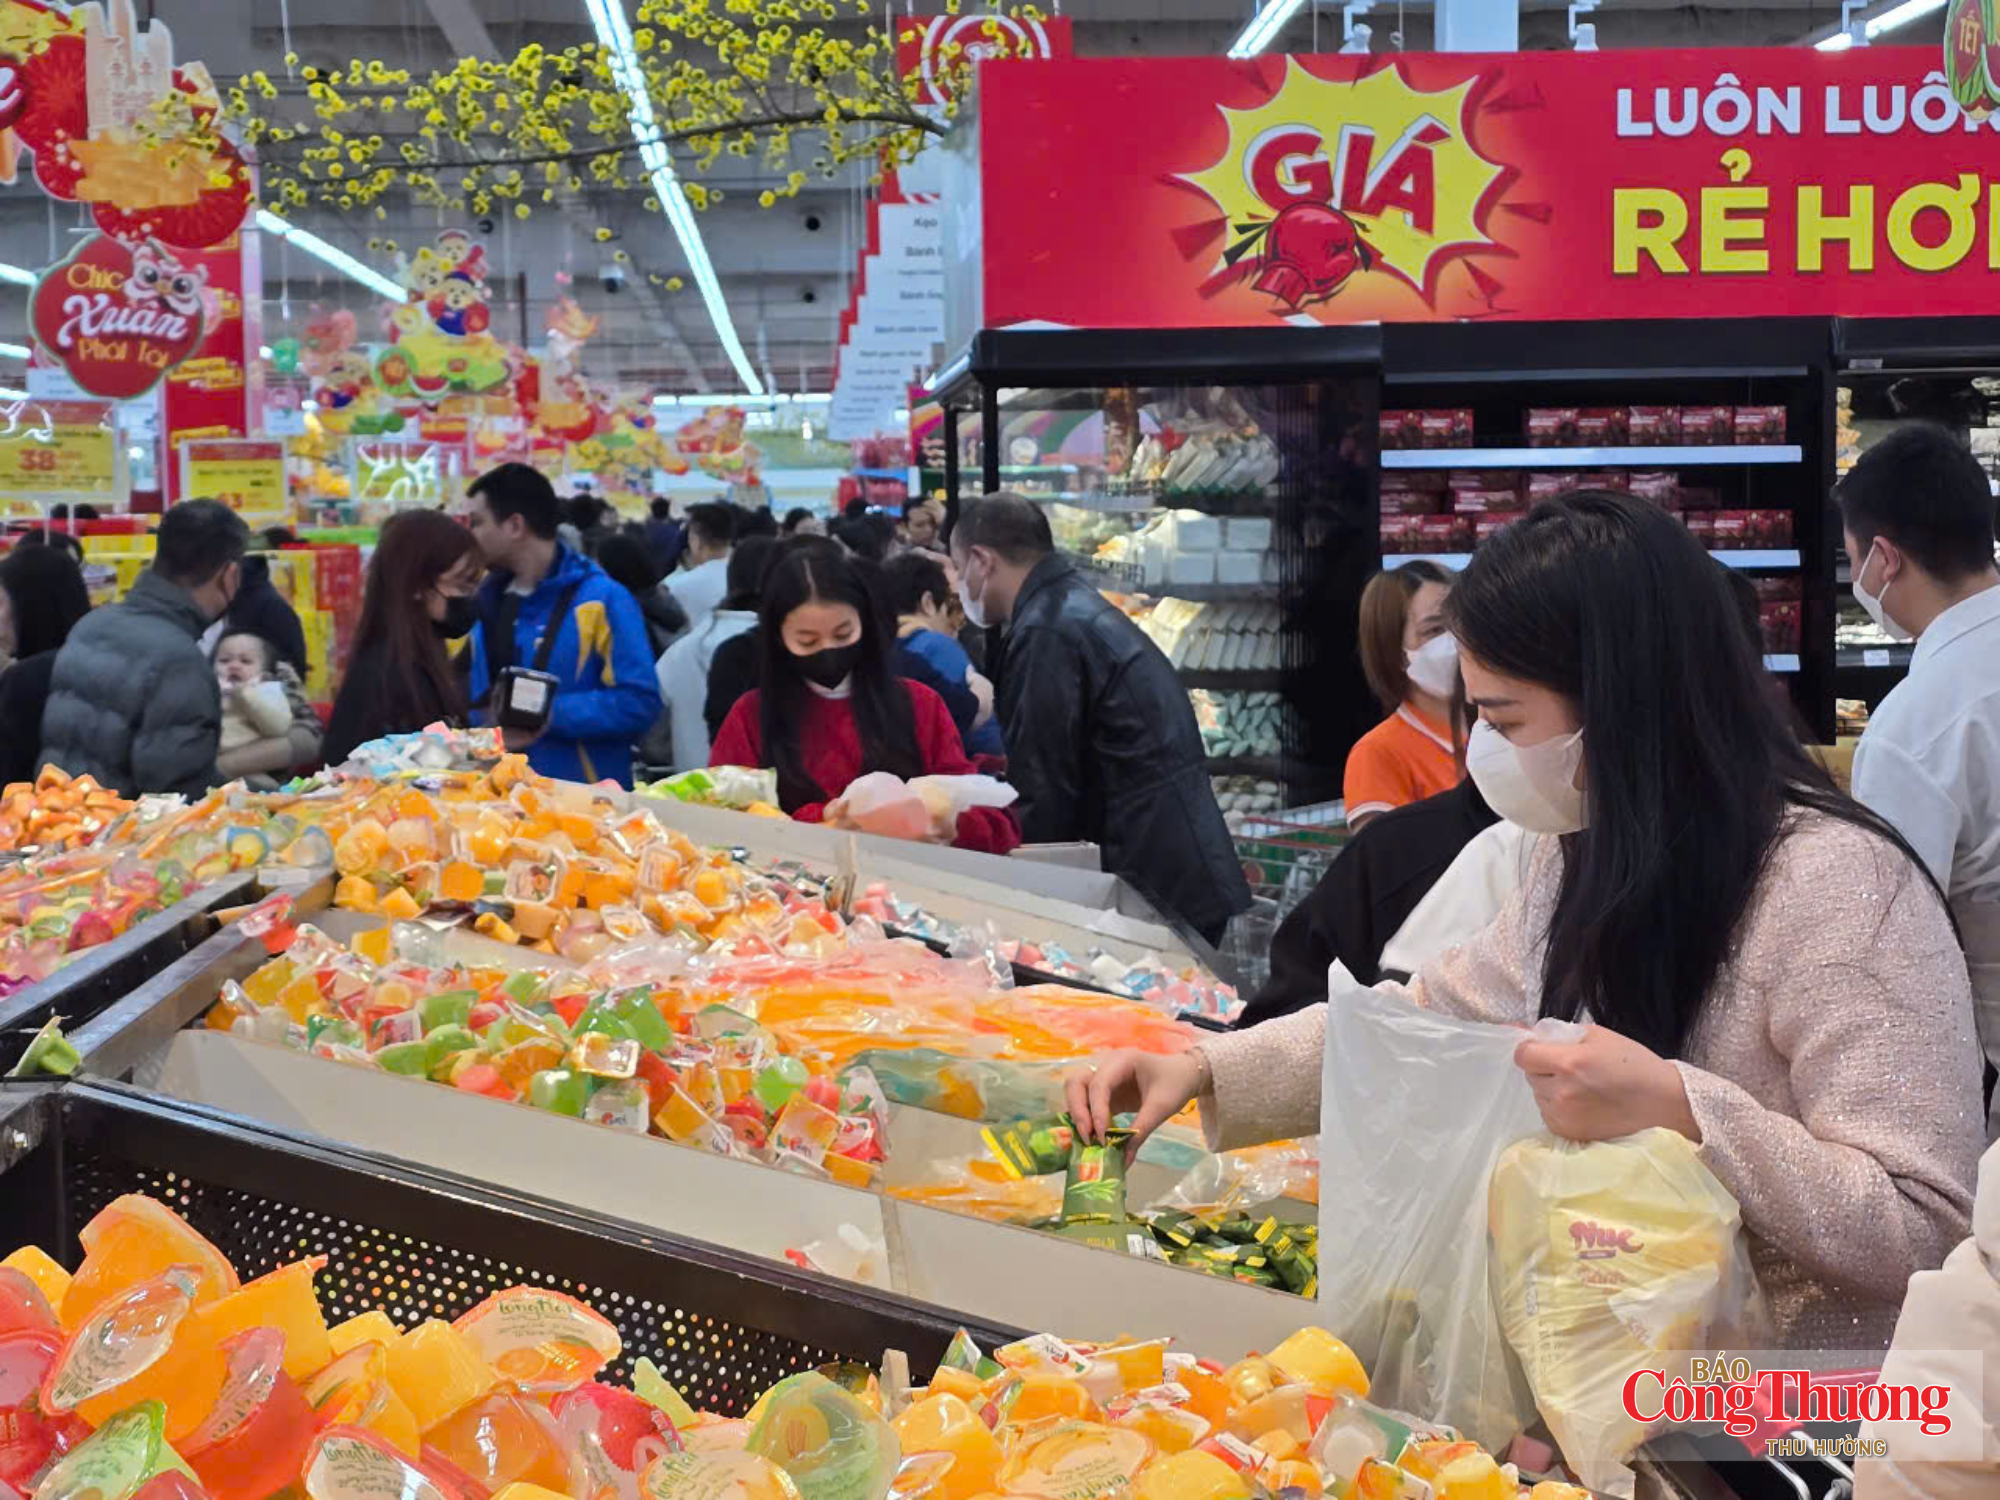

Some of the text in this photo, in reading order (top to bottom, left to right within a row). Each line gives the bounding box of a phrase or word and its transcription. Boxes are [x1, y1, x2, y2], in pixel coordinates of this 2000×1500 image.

[1617, 73, 1801, 136] LUÔN
[1243, 113, 1451, 236] GIÁ
[1613, 148, 2000, 273] RẺ HƠ
[57, 293, 188, 347] Xuân
